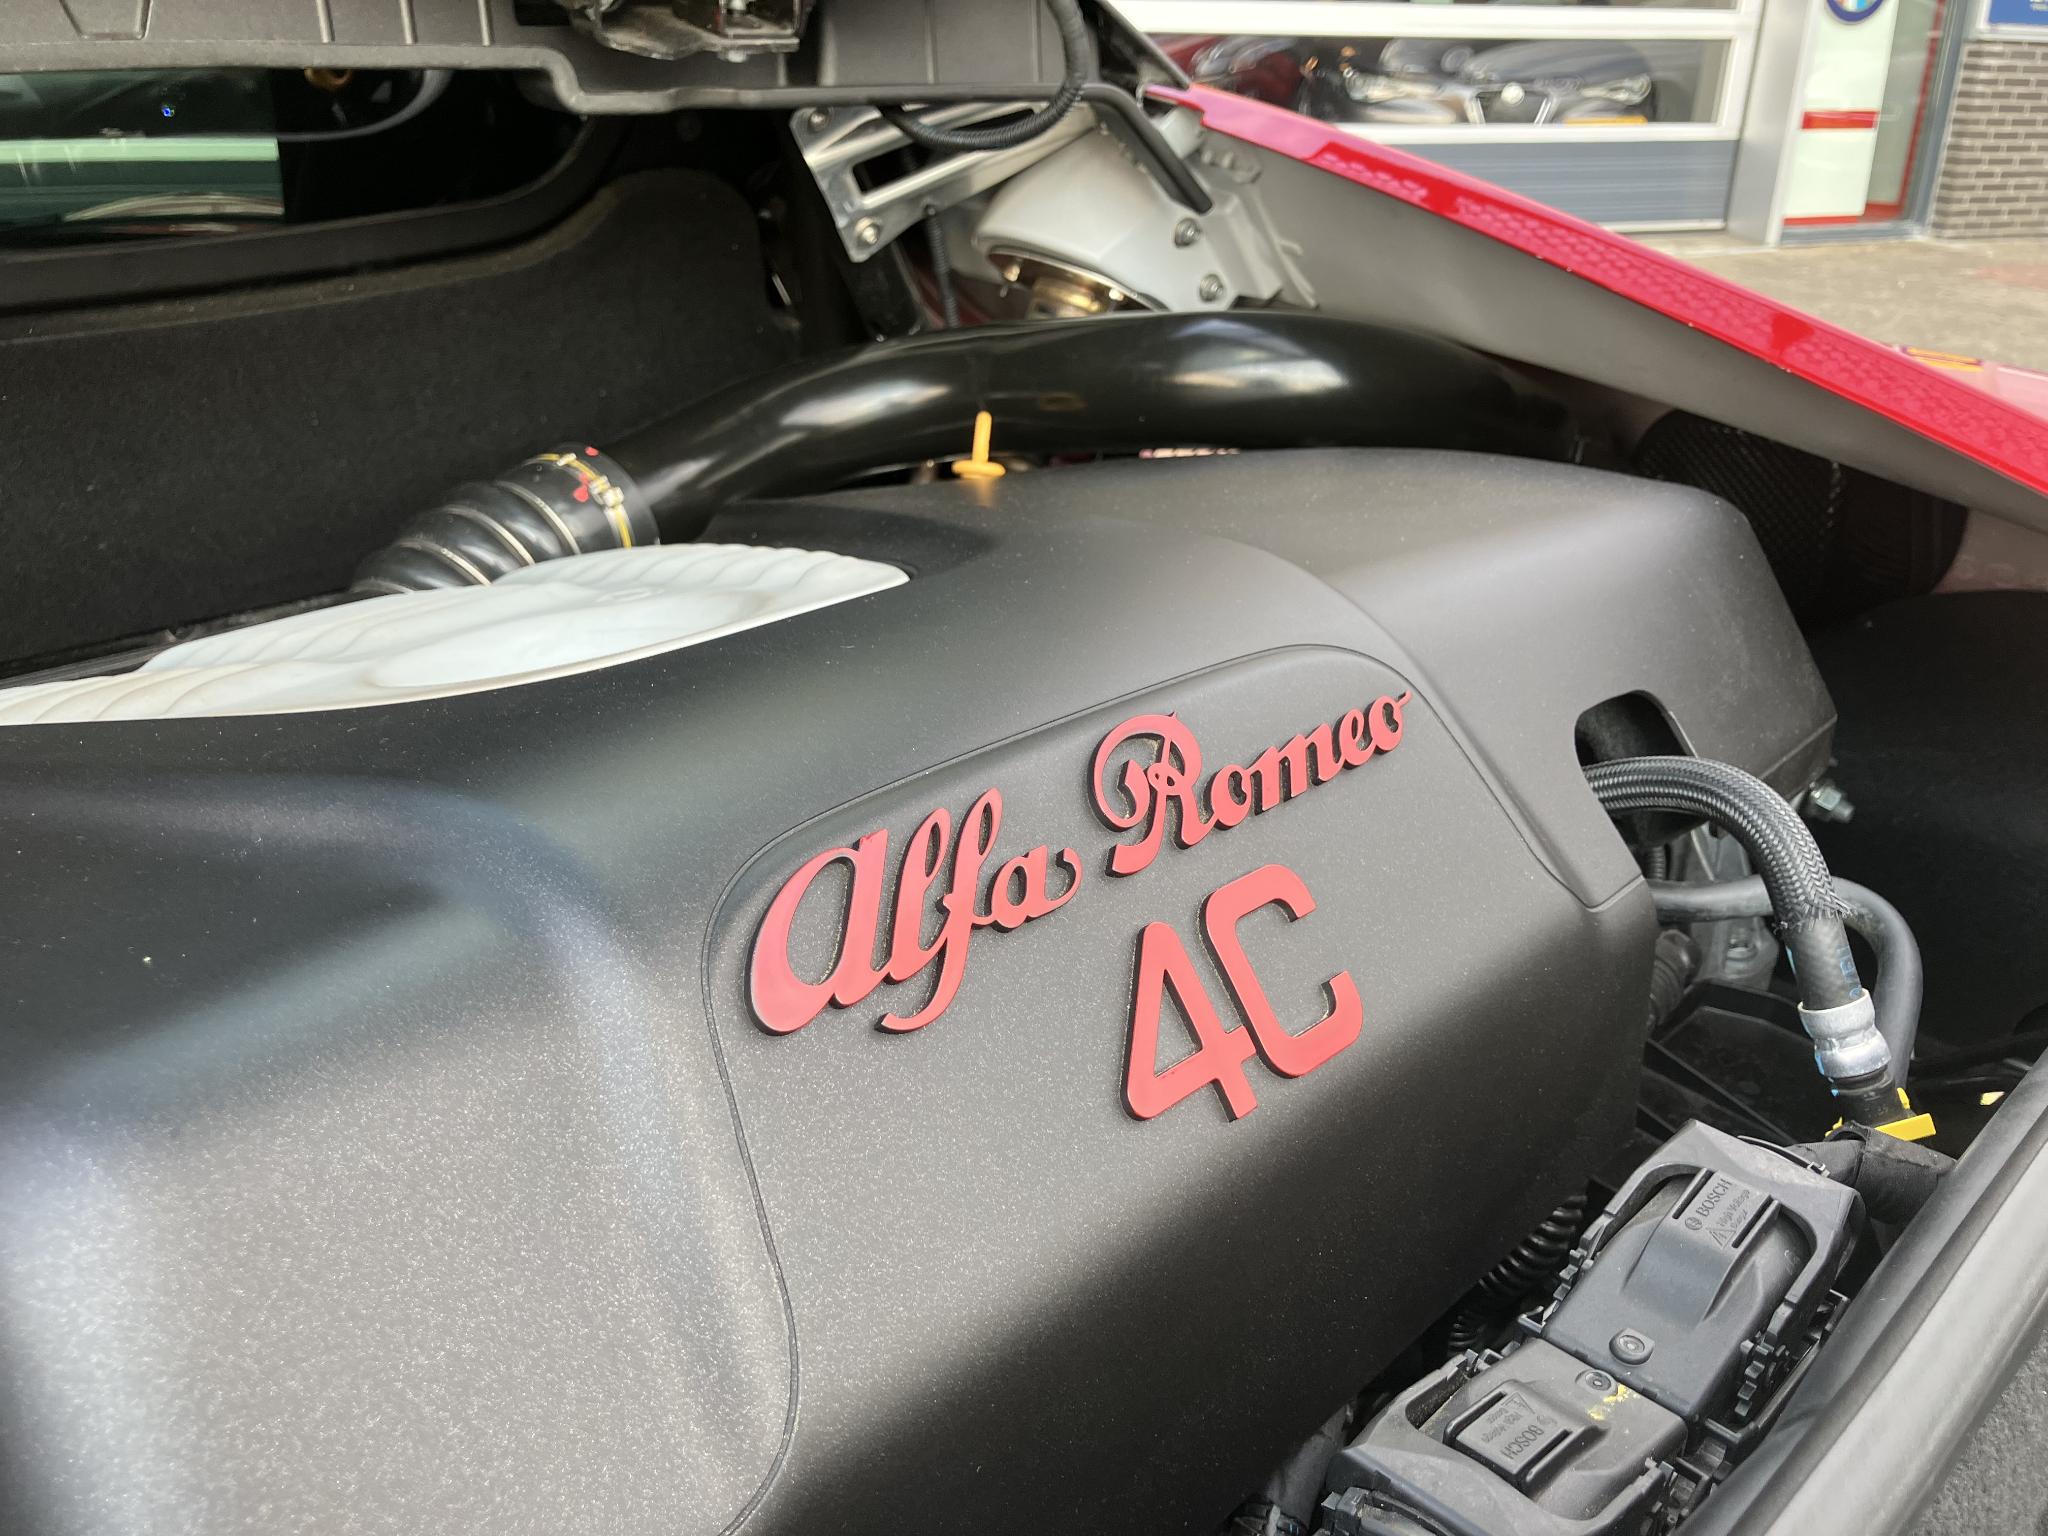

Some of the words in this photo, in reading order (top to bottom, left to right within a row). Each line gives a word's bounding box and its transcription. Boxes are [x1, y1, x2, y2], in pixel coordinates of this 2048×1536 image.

[749, 788, 1083, 1036] Alfa
[1090, 690, 1412, 877] Romeo
[1122, 863, 1364, 1121] 4C
[1696, 1178, 1733, 1217] BOSCH
[1500, 1424, 1545, 1460] BOSCH
